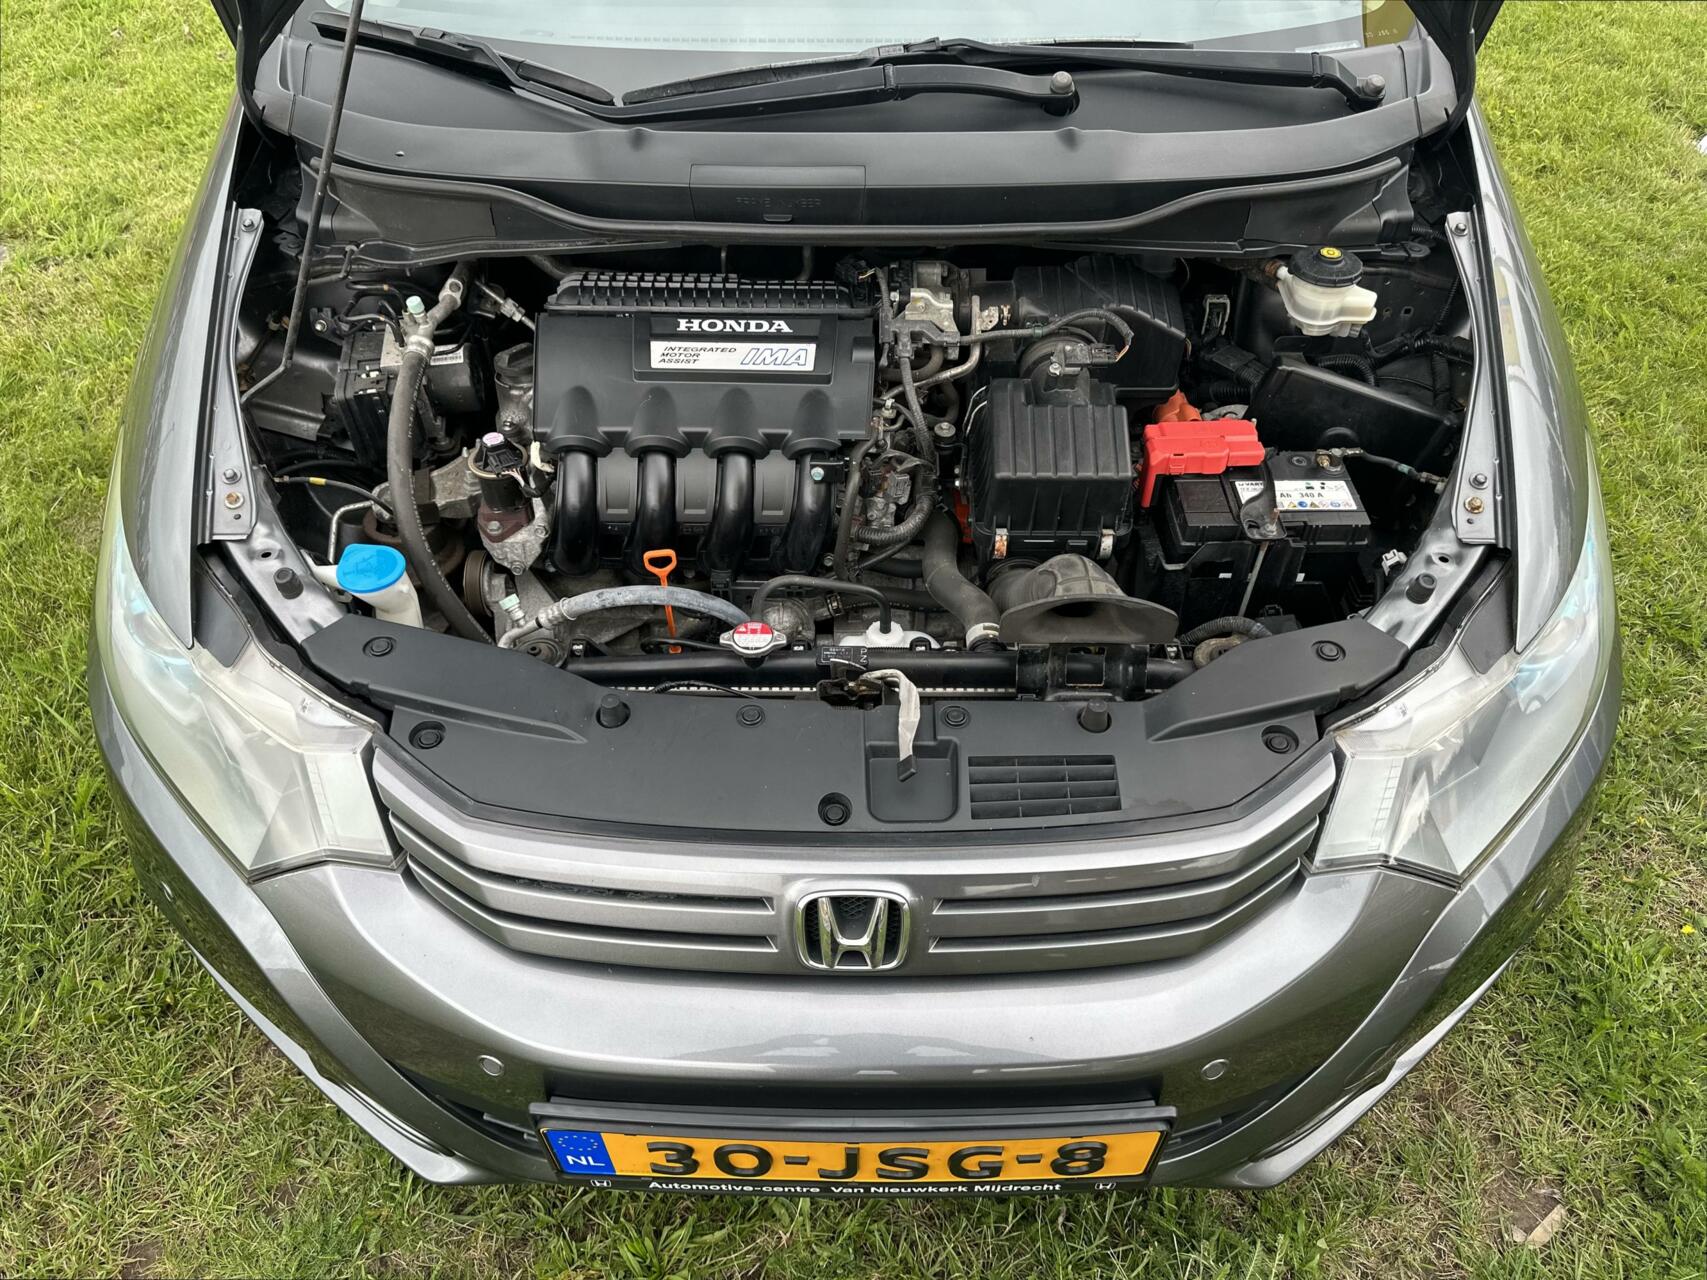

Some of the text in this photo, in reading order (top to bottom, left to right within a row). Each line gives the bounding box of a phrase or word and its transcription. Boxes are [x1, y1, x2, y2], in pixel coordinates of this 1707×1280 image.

[676, 318, 794, 333] HONDA
[740, 347, 808, 366] IMA
[566, 1155, 606, 1167] NL
[646, 1141, 1108, 1180] 30-JSG-8
[649, 1181, 1062, 1194] Automotive-centre Van Nieuwkerk Mijdrecht
